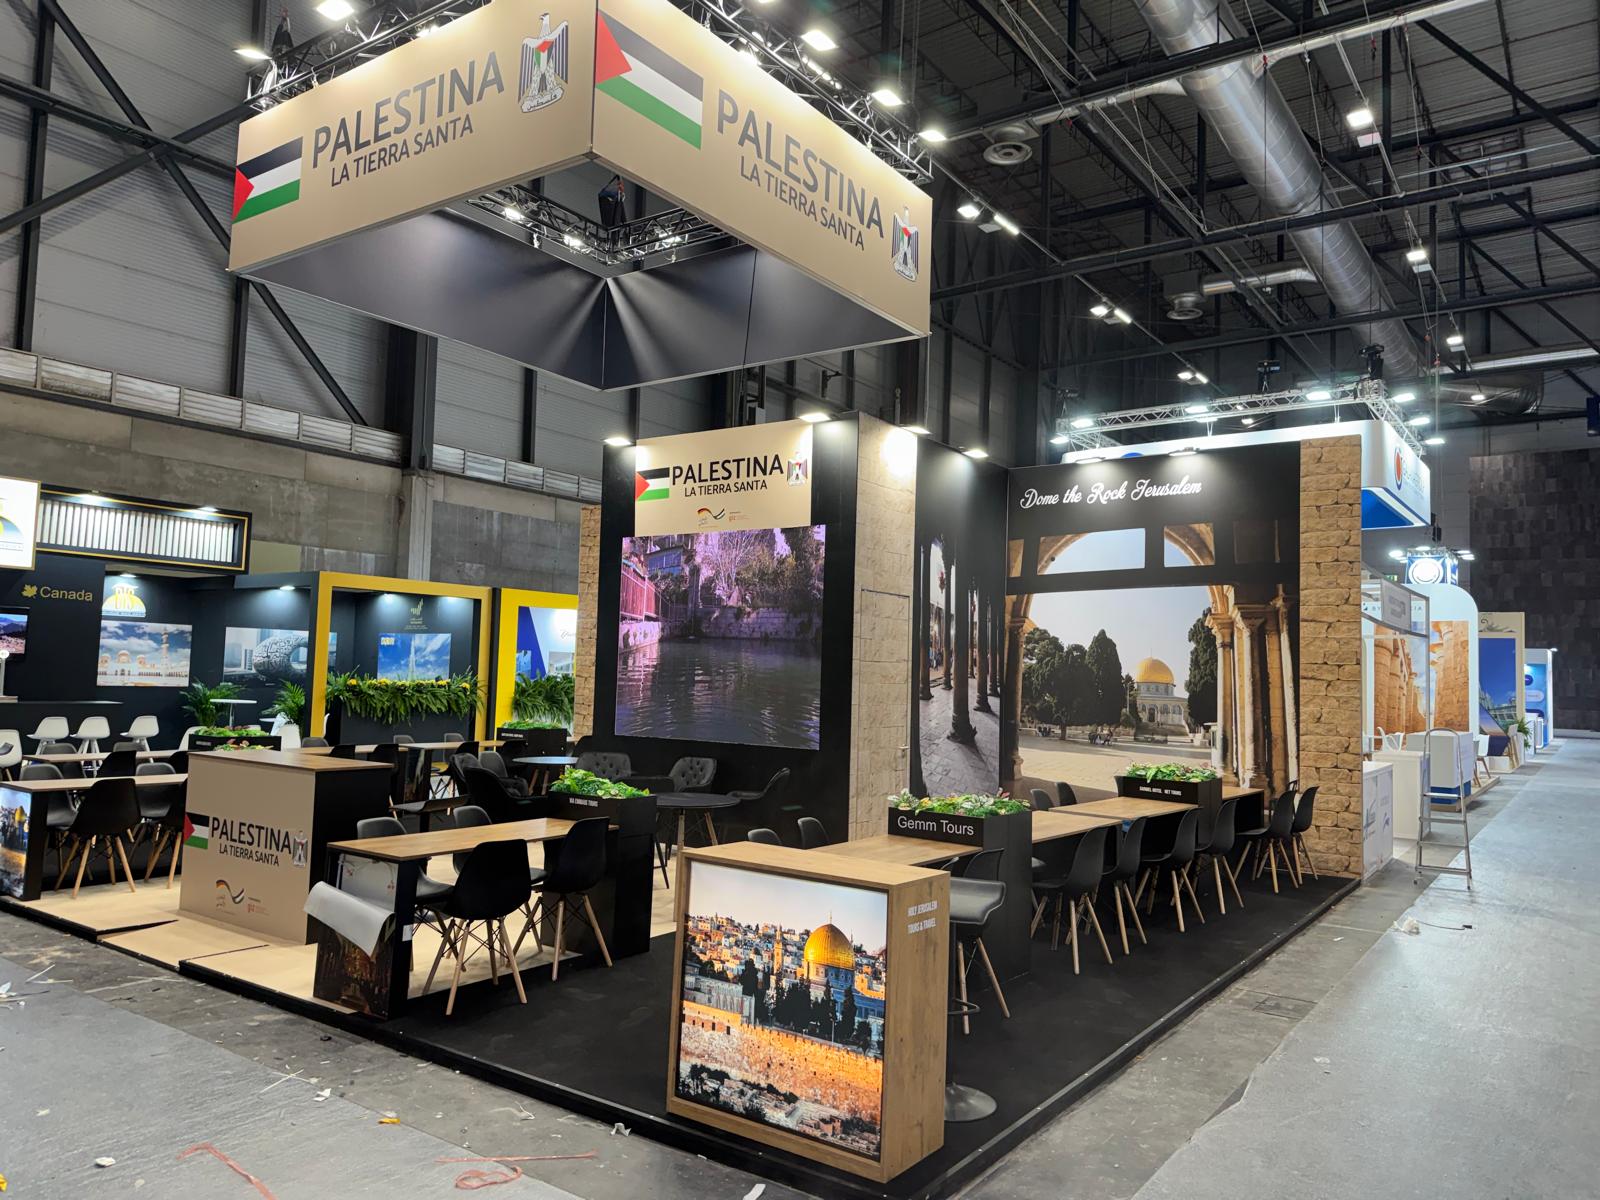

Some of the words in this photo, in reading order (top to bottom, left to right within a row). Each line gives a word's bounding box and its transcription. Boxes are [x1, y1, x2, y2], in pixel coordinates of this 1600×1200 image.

[312, 51, 504, 169] PALESTINA
[331, 162, 350, 187] LA
[353, 138, 410, 178] TIERRA
[413, 113, 474, 155] SANTA
[717, 88, 884, 239] PALESTINA
[740, 155, 761, 187] LA
[764, 169, 818, 222] TIERRA
[820, 206, 865, 251] SANTA
[672, 454, 784, 486] PALESTINA
[684, 487, 697, 498] LA
[698, 482, 732, 496] TIERRA
[733, 479, 768, 493] SANTA
[1020, 488, 1060, 509] Dome
[1062, 484, 1082, 504] the
[1086, 480, 1128, 505] Rock
[1130, 475, 1202, 501] Jerusalem
[40, 586, 93, 601] Canada
[211, 816, 292, 855] PALESTINA
[897, 815, 937, 832] Gemm
[940, 820, 975, 836] Tours
[219, 843, 228, 855] LA
[229, 845, 254, 861] TIERRA
[254, 850, 280, 867] SANTA
